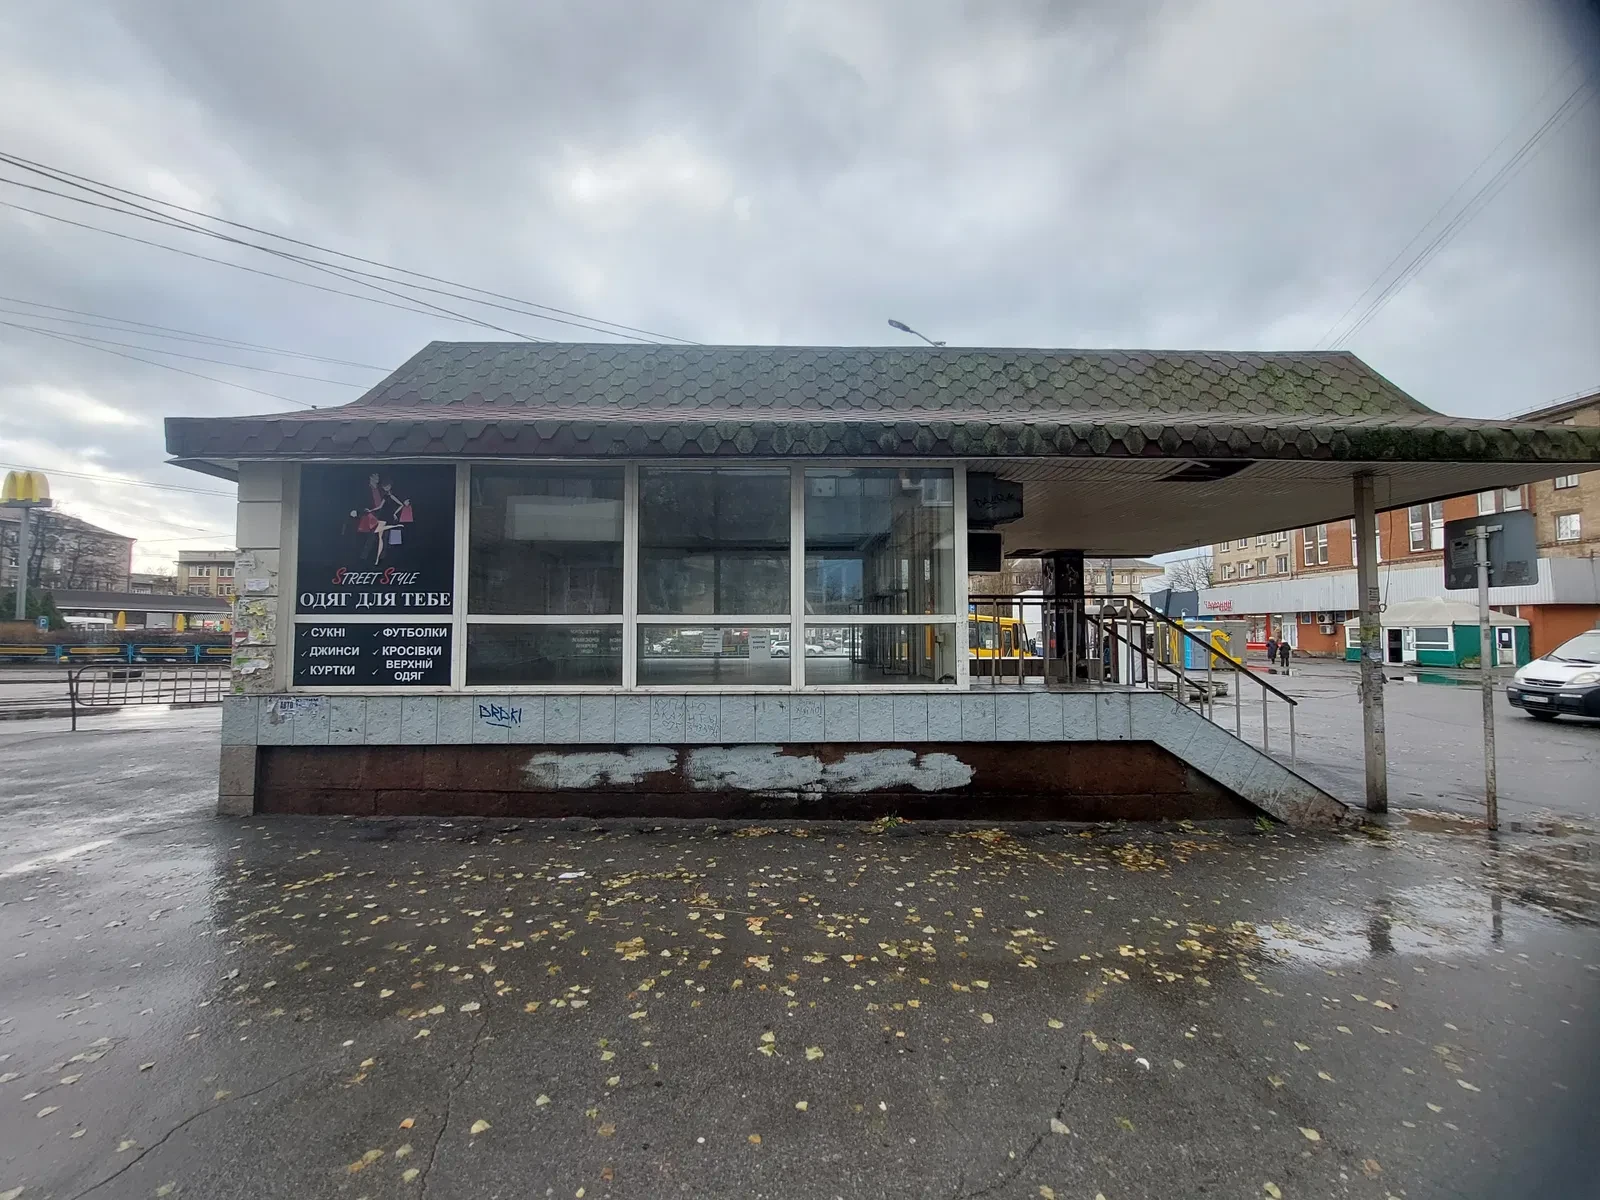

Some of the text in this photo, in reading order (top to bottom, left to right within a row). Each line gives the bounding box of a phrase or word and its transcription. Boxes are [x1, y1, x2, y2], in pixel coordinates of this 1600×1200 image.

[300, 592, 451, 609] ОДЯГ ДЛЯ ТЕБЕ
[311, 628, 346, 637] СУКНІ
[382, 628, 447, 637] ФУТБОЛКИ
[309, 646, 360, 657] ДЖИНСИ
[382, 646, 442, 656] КРОСІВКИ
[386, 658, 433, 669] ВЕРХНІЙ
[310, 665, 356, 675] КУРТКИ
[394, 672, 425, 681] ОДЯГ
